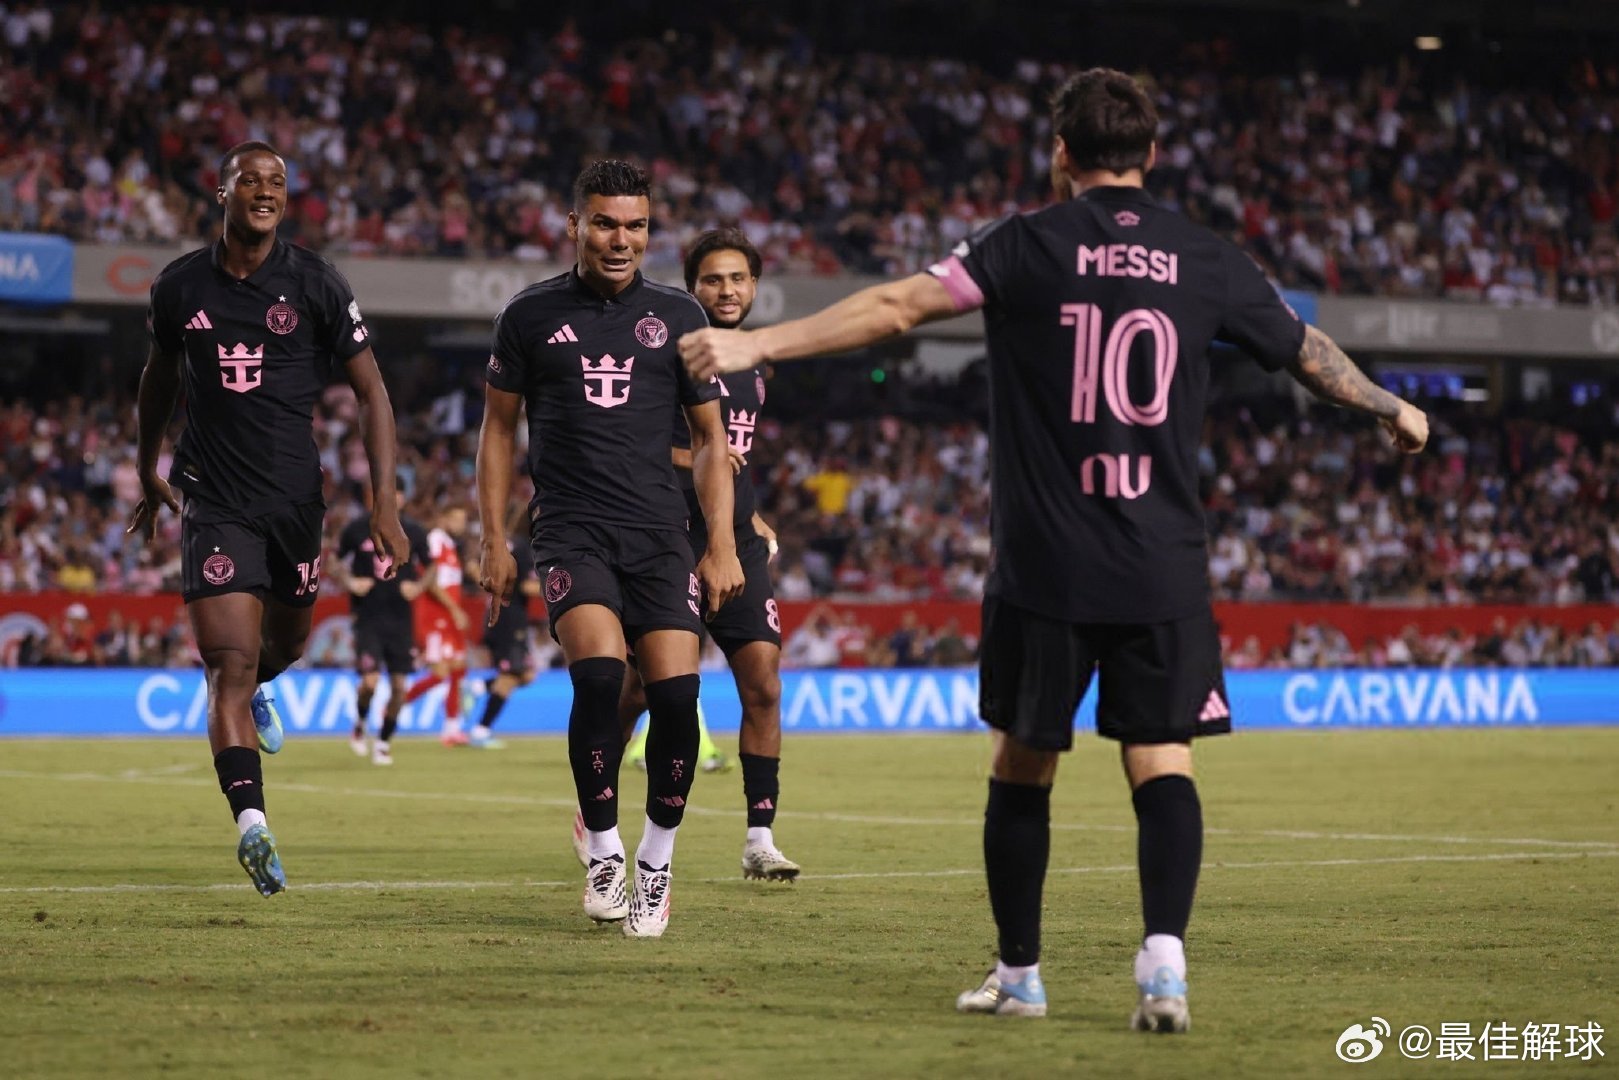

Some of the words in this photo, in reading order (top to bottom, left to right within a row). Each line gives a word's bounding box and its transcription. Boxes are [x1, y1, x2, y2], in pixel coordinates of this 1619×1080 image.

[1077, 244, 1178, 285] MESSI
[1059, 302, 1179, 426] 10
[765, 598, 781, 634] 8
[1283, 672, 1539, 723] CARVANA
